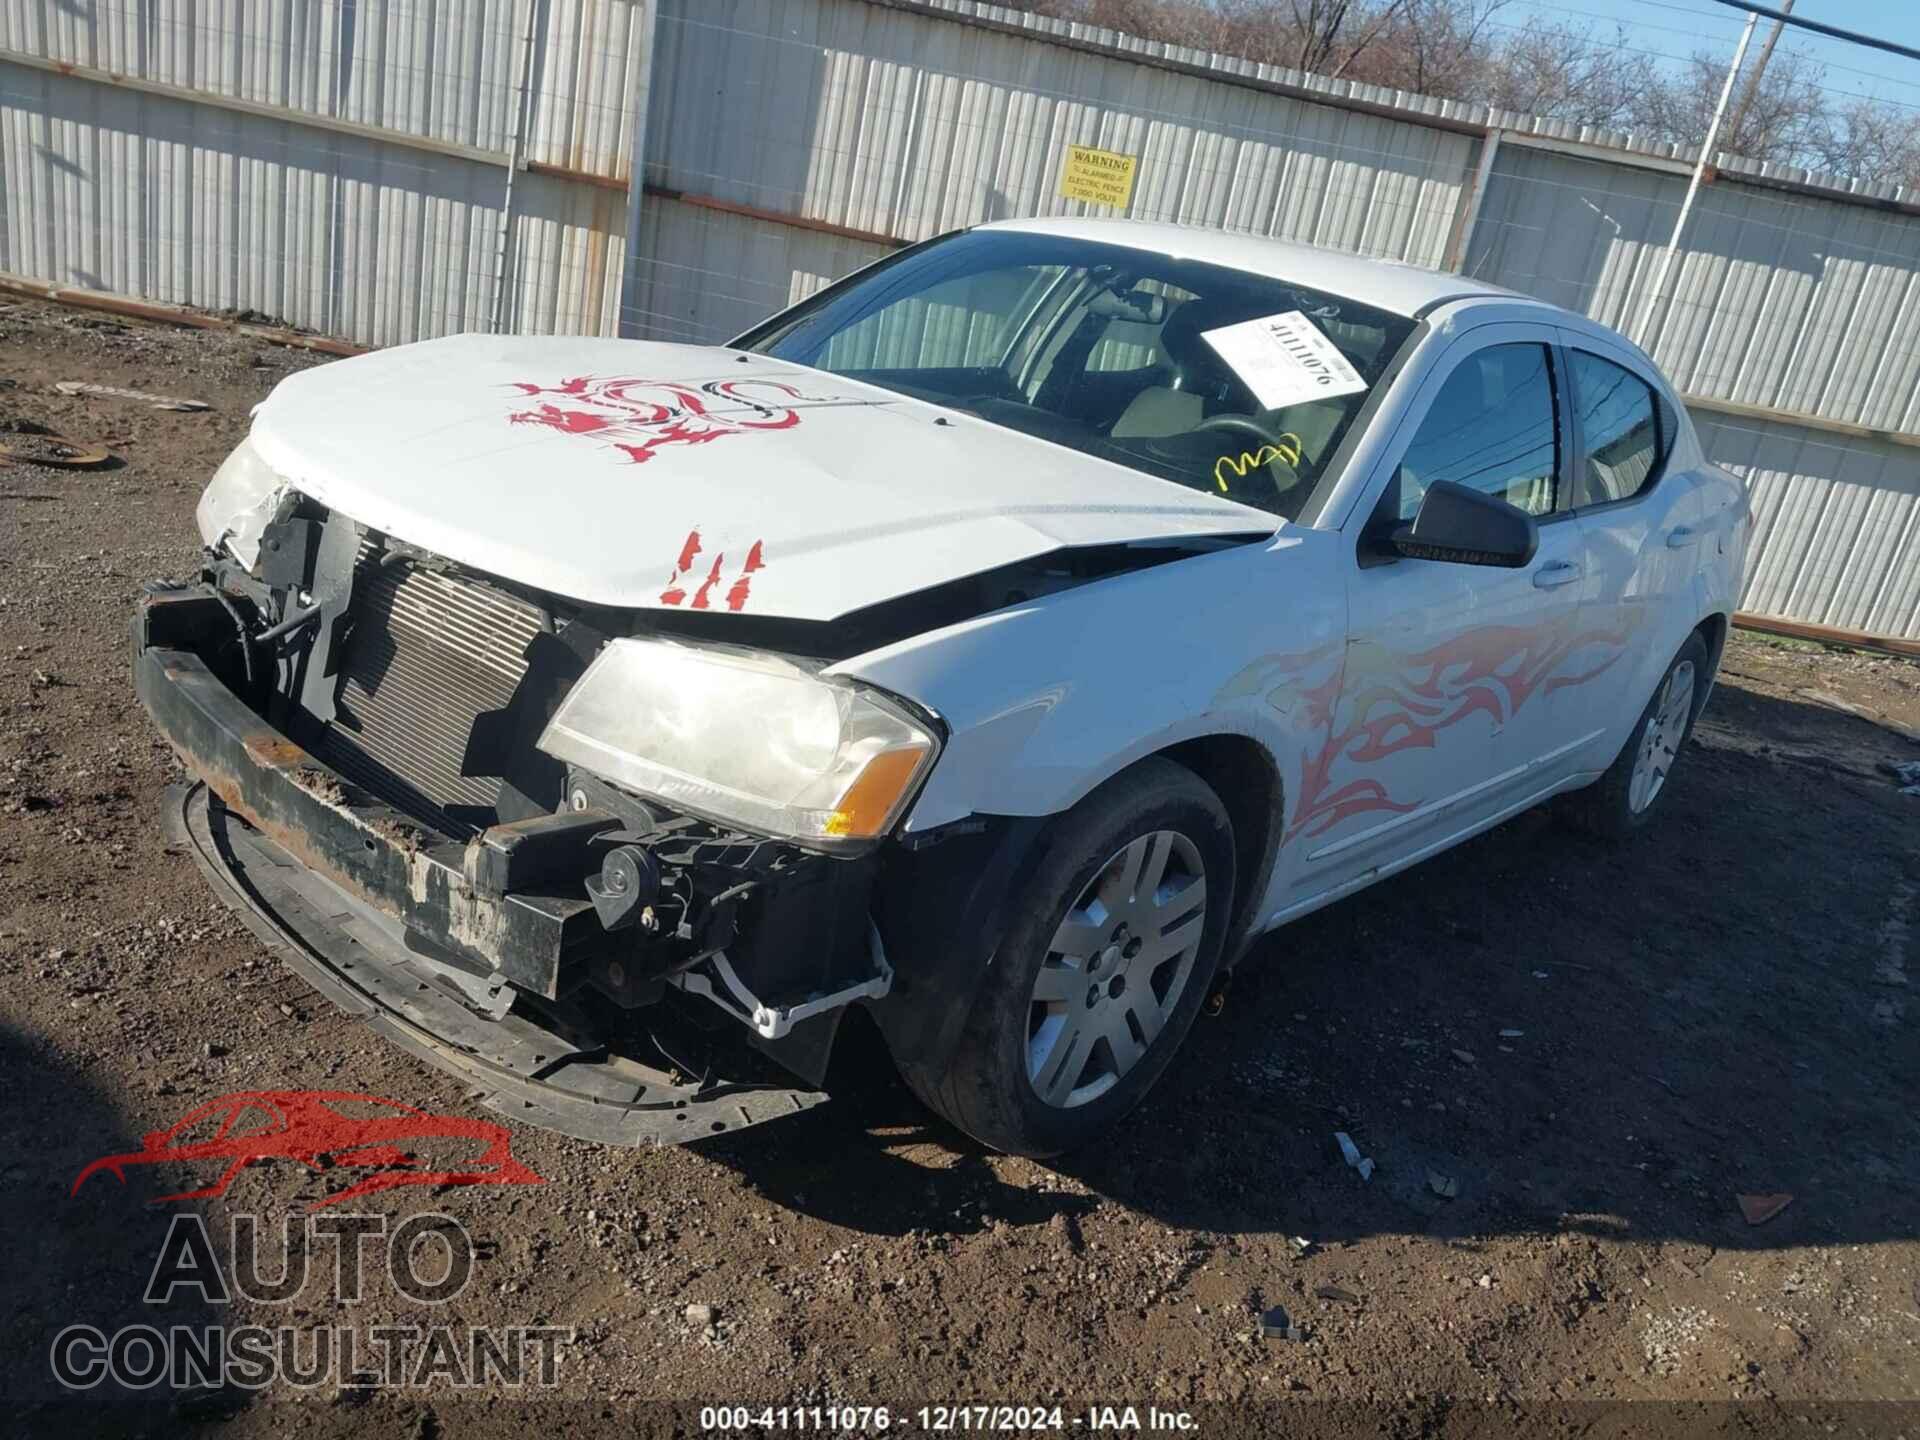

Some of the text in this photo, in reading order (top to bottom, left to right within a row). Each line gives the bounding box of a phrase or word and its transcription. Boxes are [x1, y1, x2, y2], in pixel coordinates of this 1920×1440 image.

[1074, 151, 1130, 171] WARNING
[1068, 176, 1125, 193] ELECTRIC FENCE
[1269, 323, 1336, 385] 41111076
